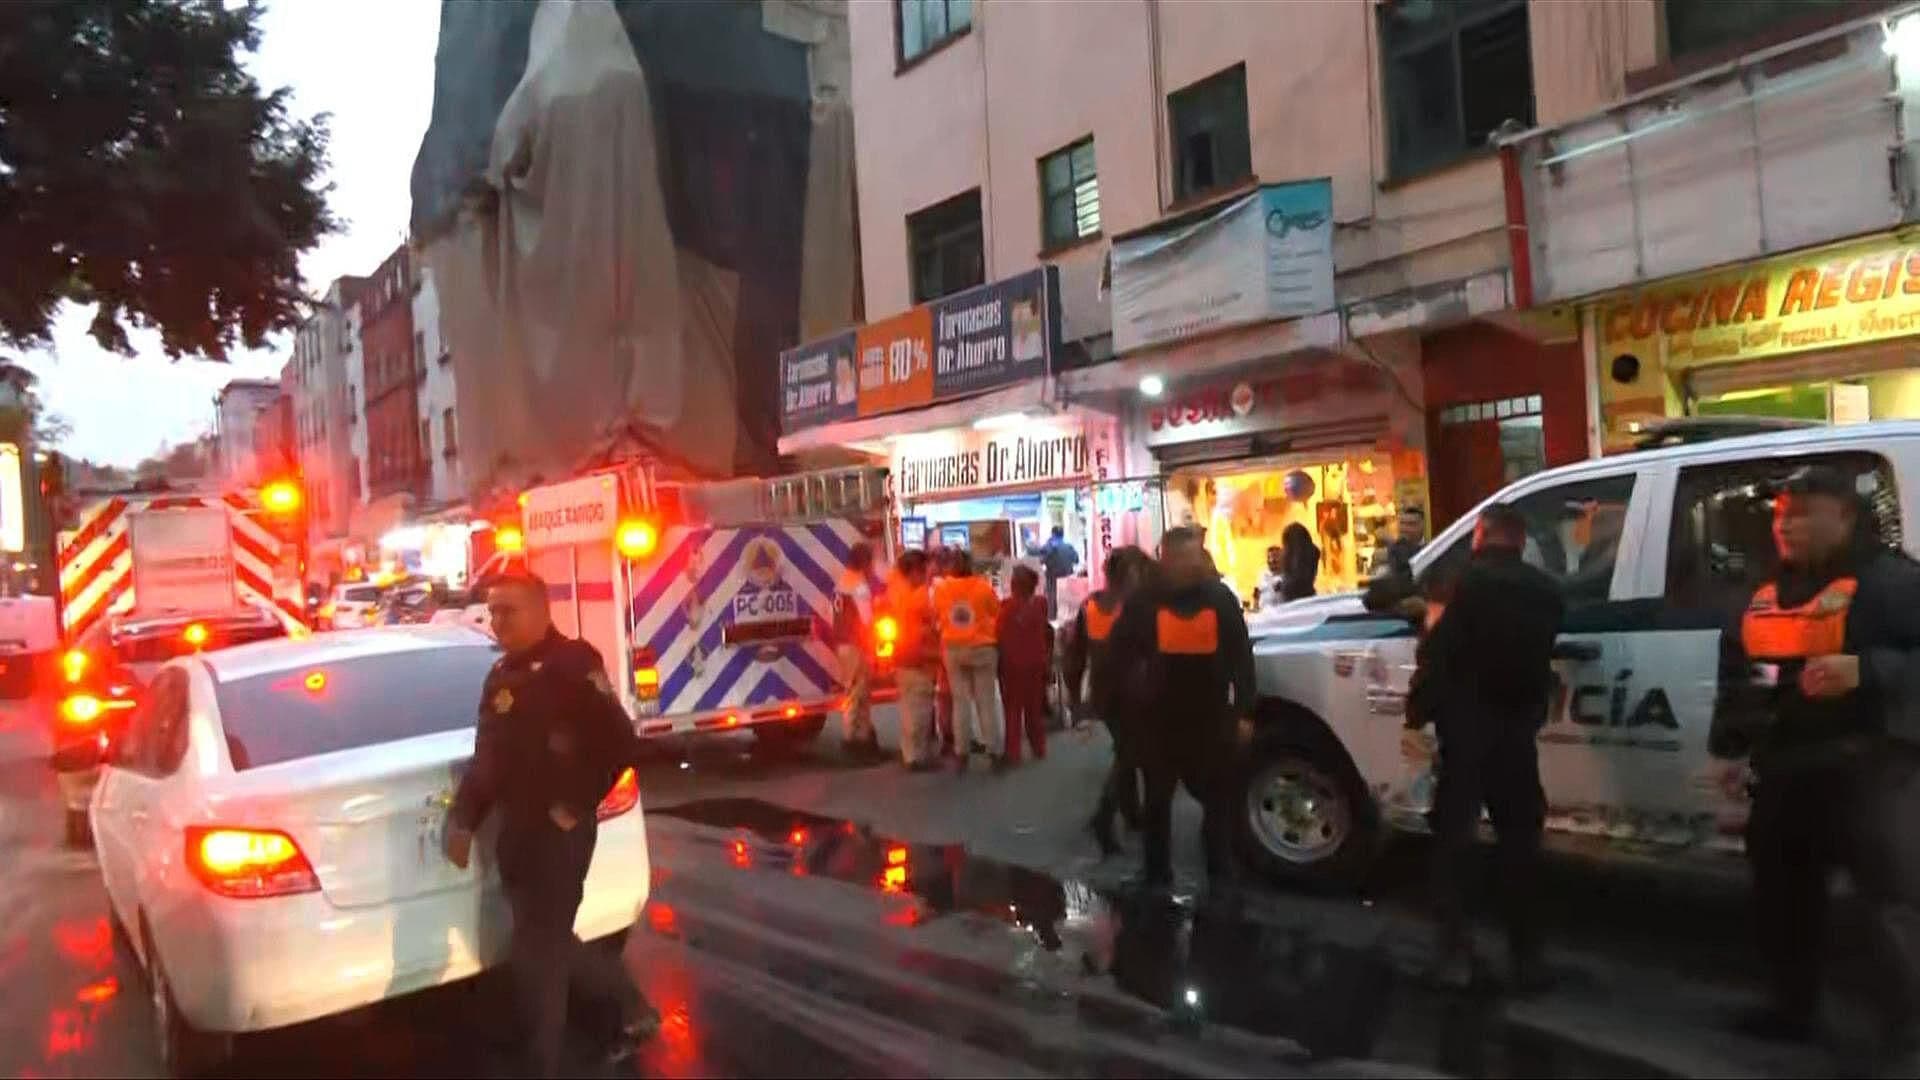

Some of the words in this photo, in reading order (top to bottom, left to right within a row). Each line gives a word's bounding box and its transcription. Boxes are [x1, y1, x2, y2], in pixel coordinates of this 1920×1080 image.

[939, 299, 1002, 342] Farmacias
[1604, 277, 1769, 346] COCINA
[957, 335, 1005, 370] Ahorro
[900, 446, 981, 496] Farmacias
[1013, 432, 1087, 482] Ahorro
